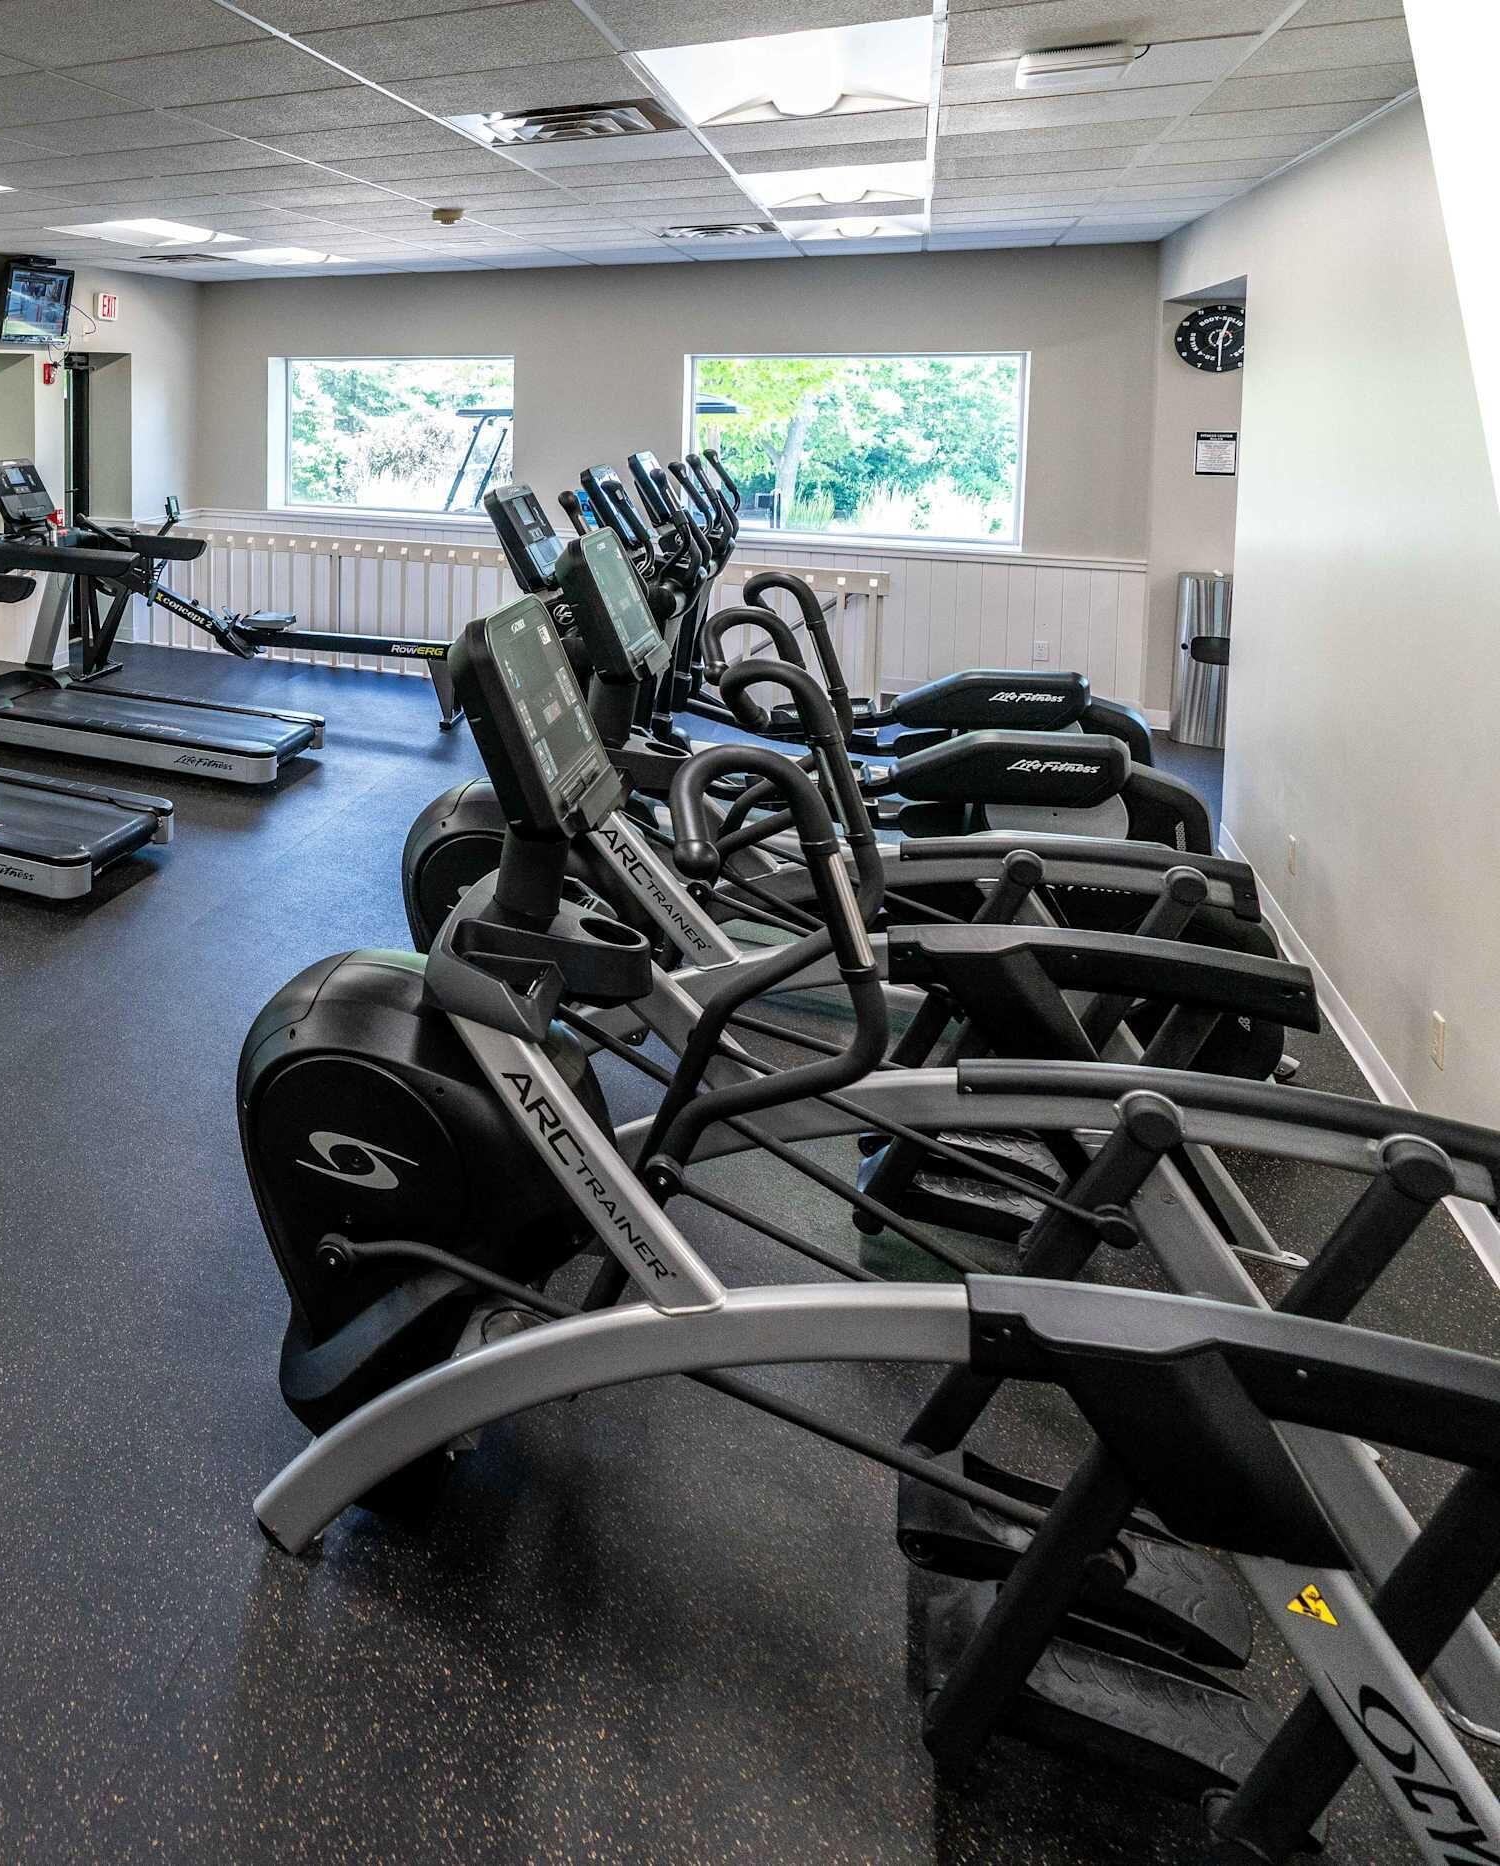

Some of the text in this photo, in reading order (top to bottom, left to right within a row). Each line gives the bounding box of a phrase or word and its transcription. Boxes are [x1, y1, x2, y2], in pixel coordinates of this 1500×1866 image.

[102, 294, 117, 318] EXIT
[163, 597, 213, 629] concept 2
